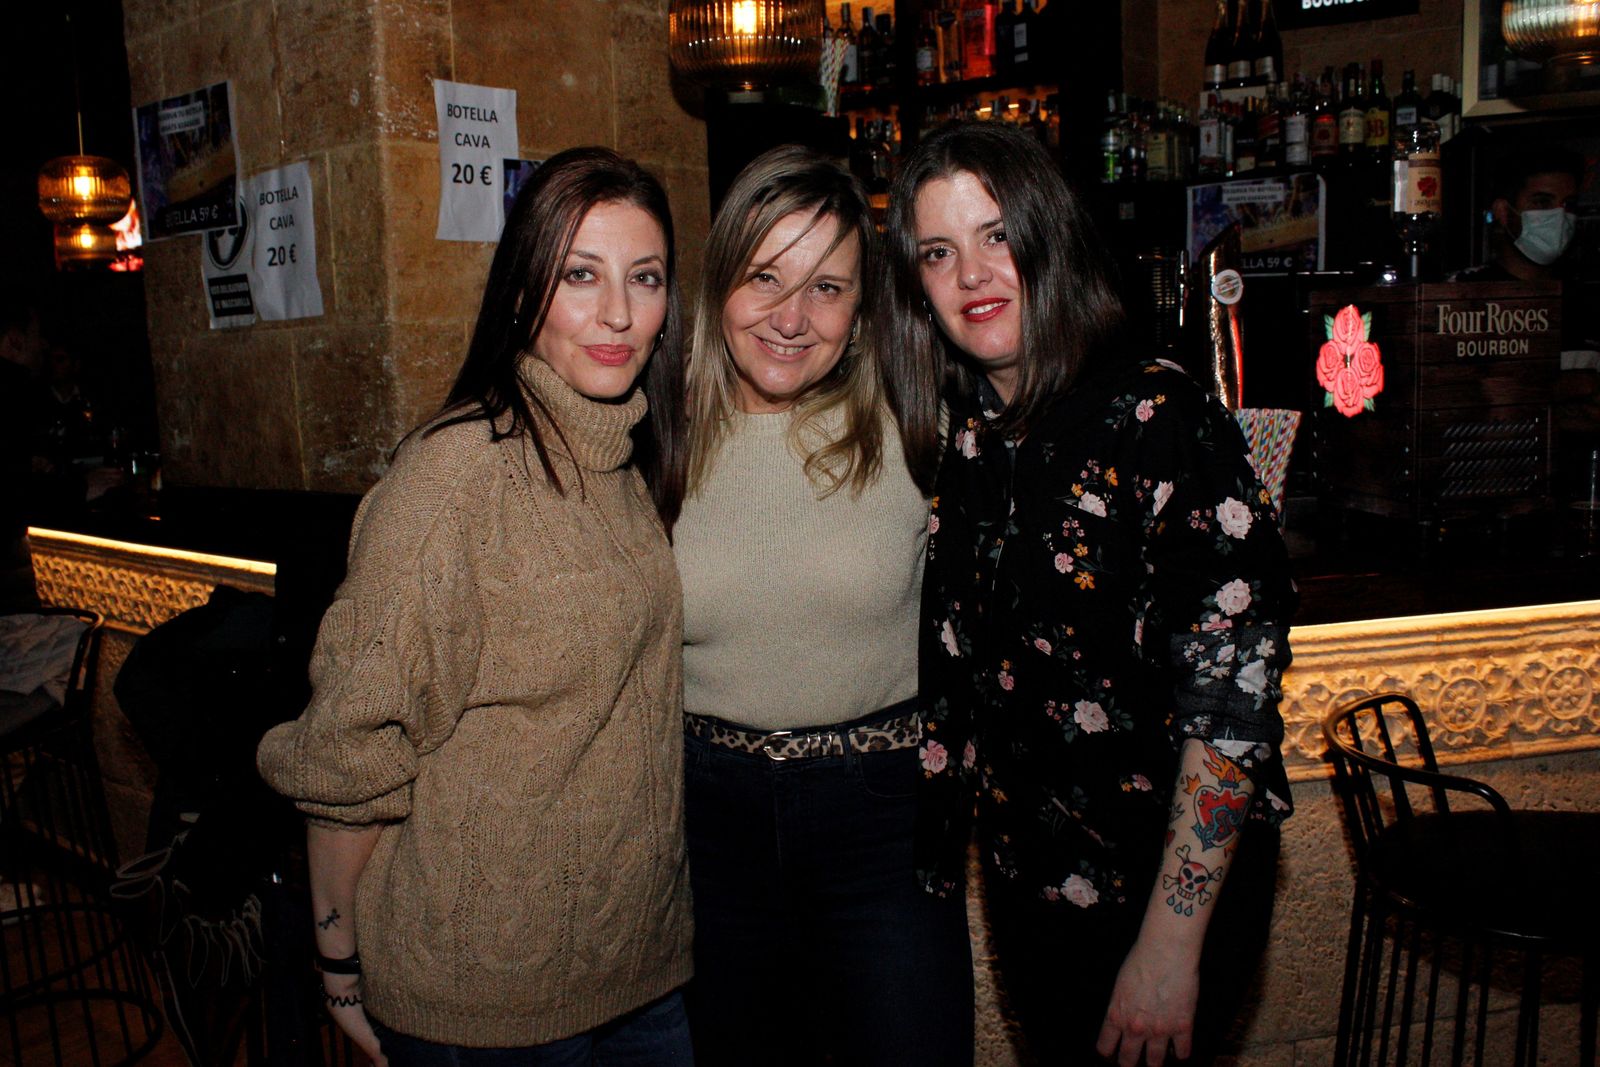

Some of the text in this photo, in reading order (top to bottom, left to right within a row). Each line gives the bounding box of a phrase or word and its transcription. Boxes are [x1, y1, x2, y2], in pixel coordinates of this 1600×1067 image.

[447, 103, 498, 123] BOTELLA
[455, 132, 490, 148] CAVA
[452, 163, 492, 185] 20 €
[259, 186, 299, 206] BOTELLA
[269, 214, 295, 230] CAVA
[268, 244, 297, 267] 20 €
[1266, 256, 1281, 269] 59
[1437, 302, 1550, 336] Four Roses
[1456, 338, 1529, 358] BOURBON
